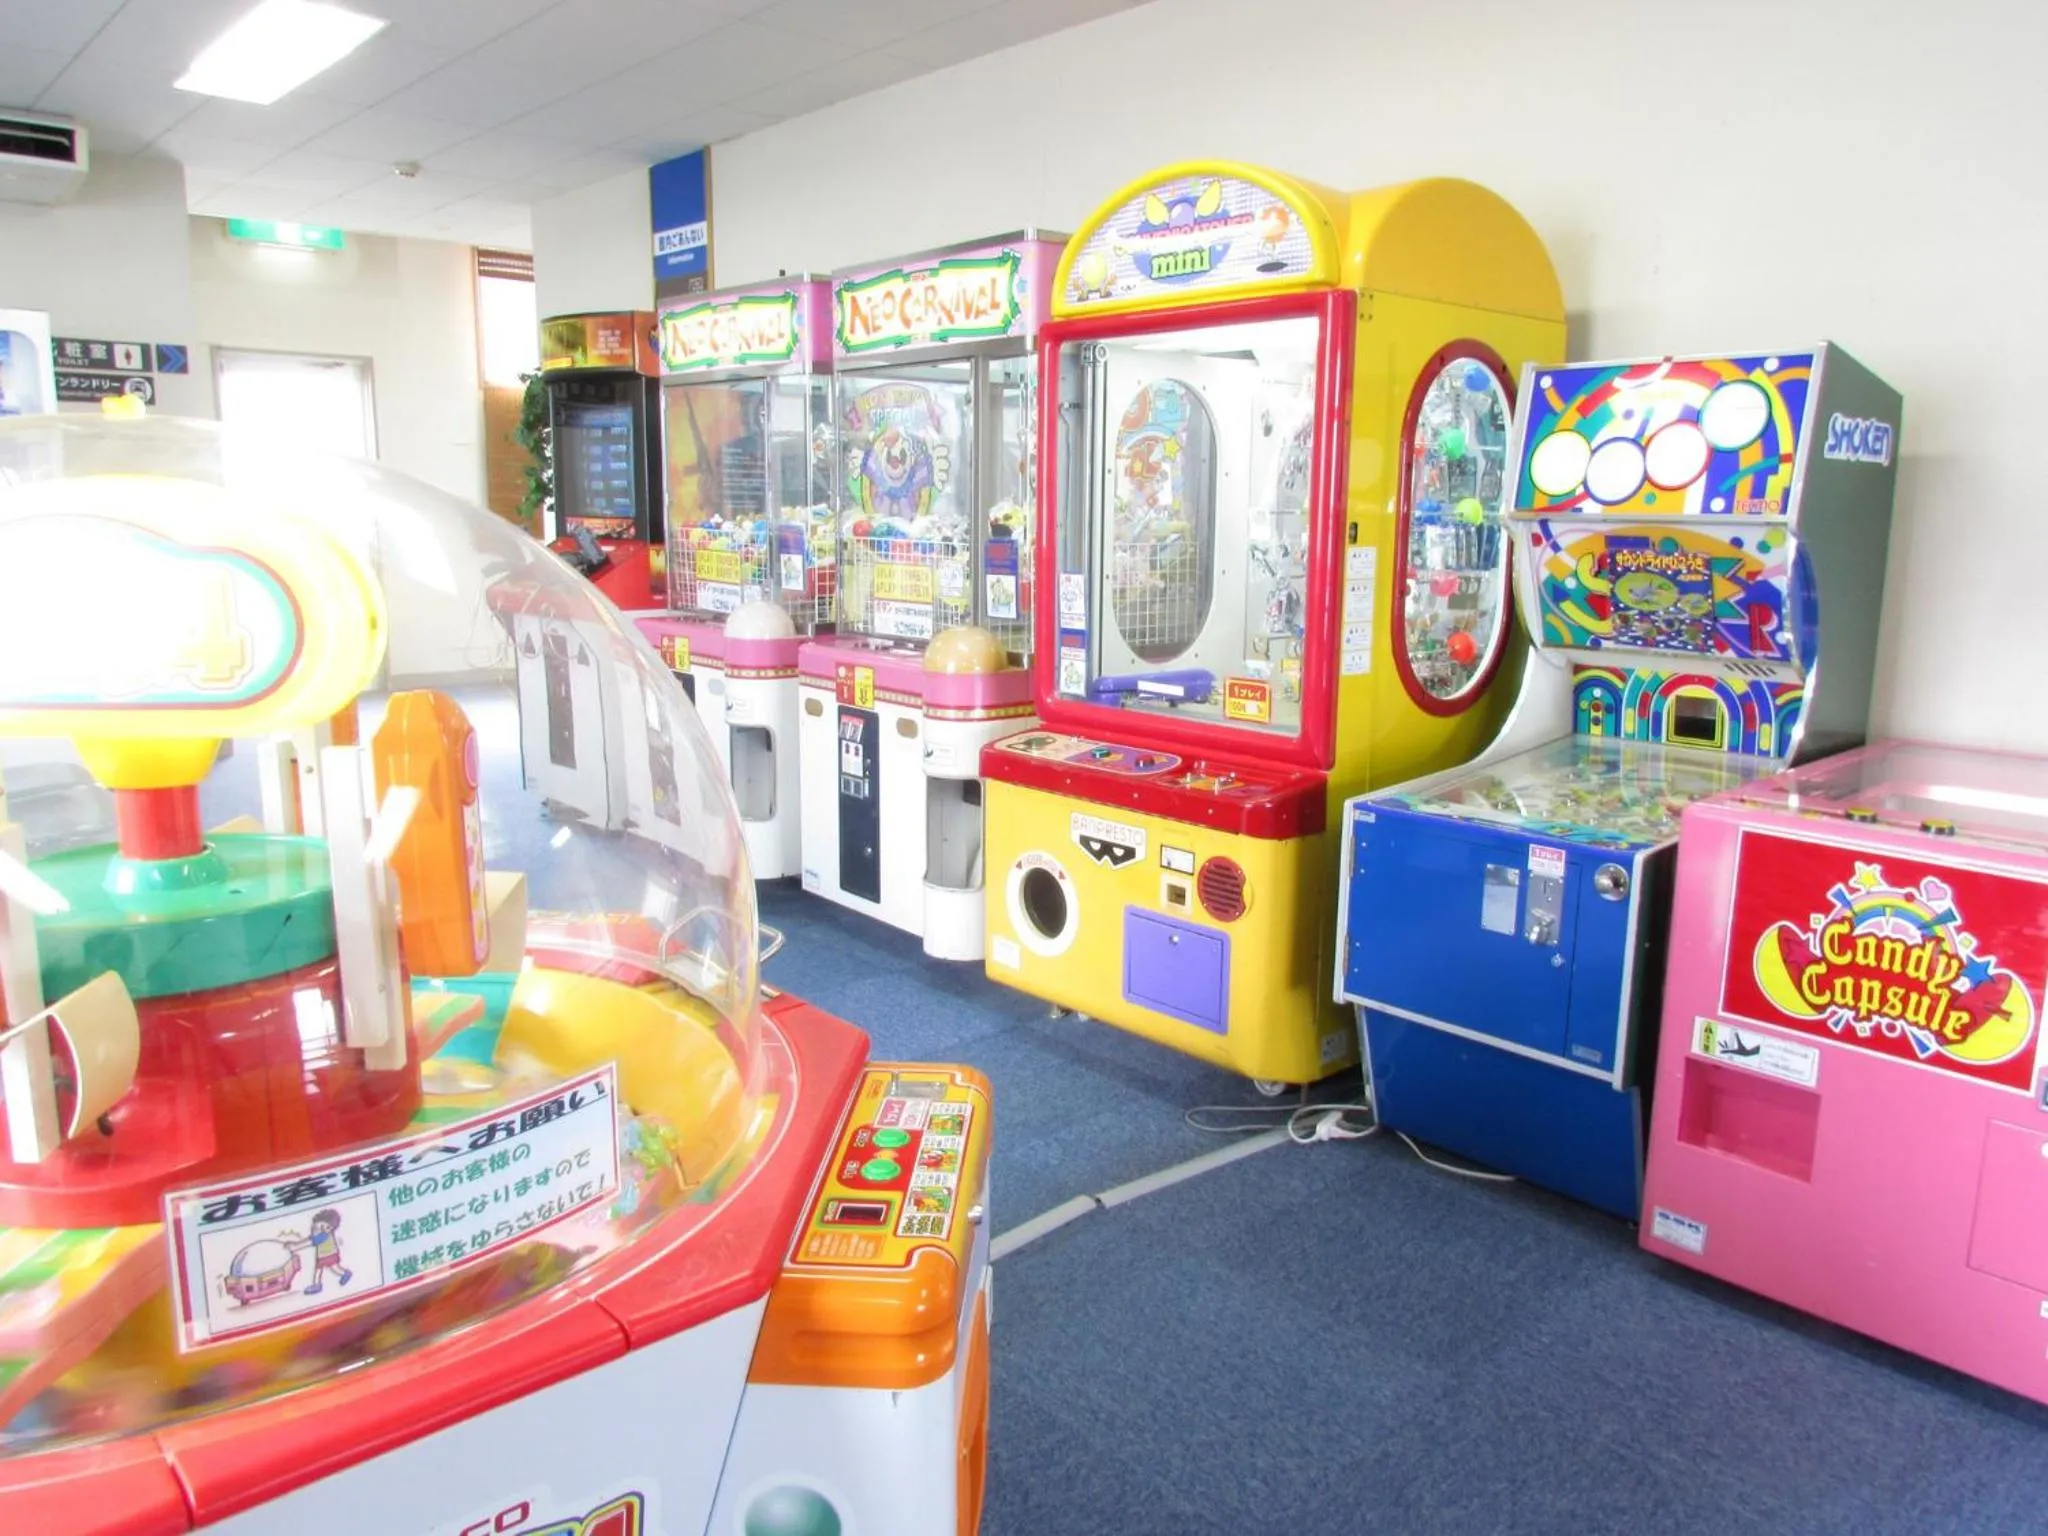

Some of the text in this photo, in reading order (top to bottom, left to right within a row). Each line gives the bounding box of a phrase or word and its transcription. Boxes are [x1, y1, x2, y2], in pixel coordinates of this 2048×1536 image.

[1151, 249, 1211, 280] mini
[849, 277, 1002, 336] NEO CARNIVAL
[1825, 413, 1891, 463] SHOKEN
[1821, 919, 1961, 996] Candy
[1801, 962, 1972, 1040] Capsule
[201, 1079, 607, 1224] お客様へお願い
[387, 1143, 530, 1208] 他のお客様の
[391, 1149, 592, 1244] 迷惑になりますので
